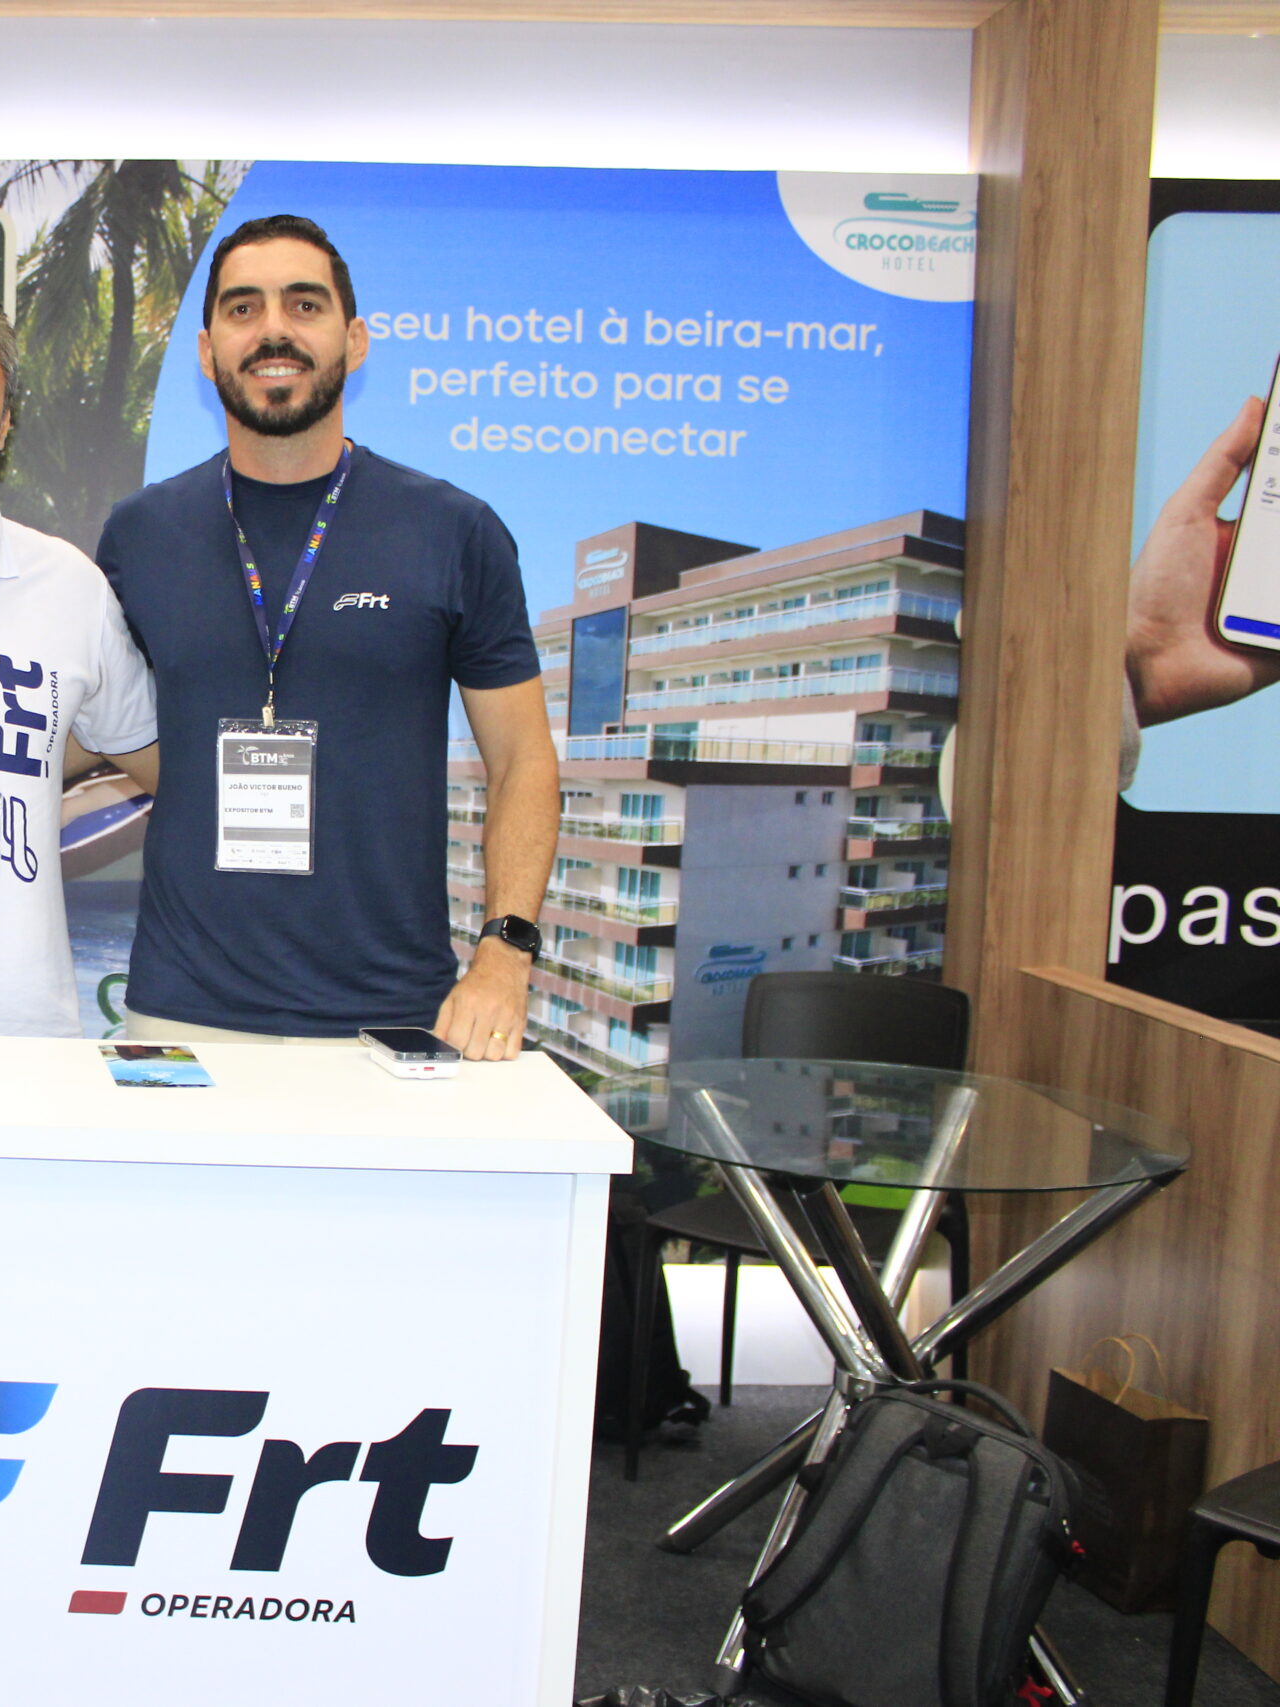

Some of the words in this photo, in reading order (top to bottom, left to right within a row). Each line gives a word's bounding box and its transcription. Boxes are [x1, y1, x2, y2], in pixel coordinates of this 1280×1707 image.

[845, 233, 975, 253] CROCOBEACH
[882, 257, 936, 272] HOTEL
[368, 311, 450, 342] seu
[466, 306, 583, 343] hotel
[599, 307, 628, 345] à
[644, 311, 885, 357] beira-mar,
[409, 362, 599, 404] perfeito
[614, 370, 721, 409] para
[737, 375, 790, 404] se
[449, 417, 747, 457] desconectar
[304, 521, 327, 564] MANAUS
[357, 592, 390, 610] Frt
[46, 670, 58, 753] OPERADORA
[251, 752, 278, 764] BTM
[80, 1387, 480, 1577] Frt
[140, 1593, 357, 1623] OPERADORA
